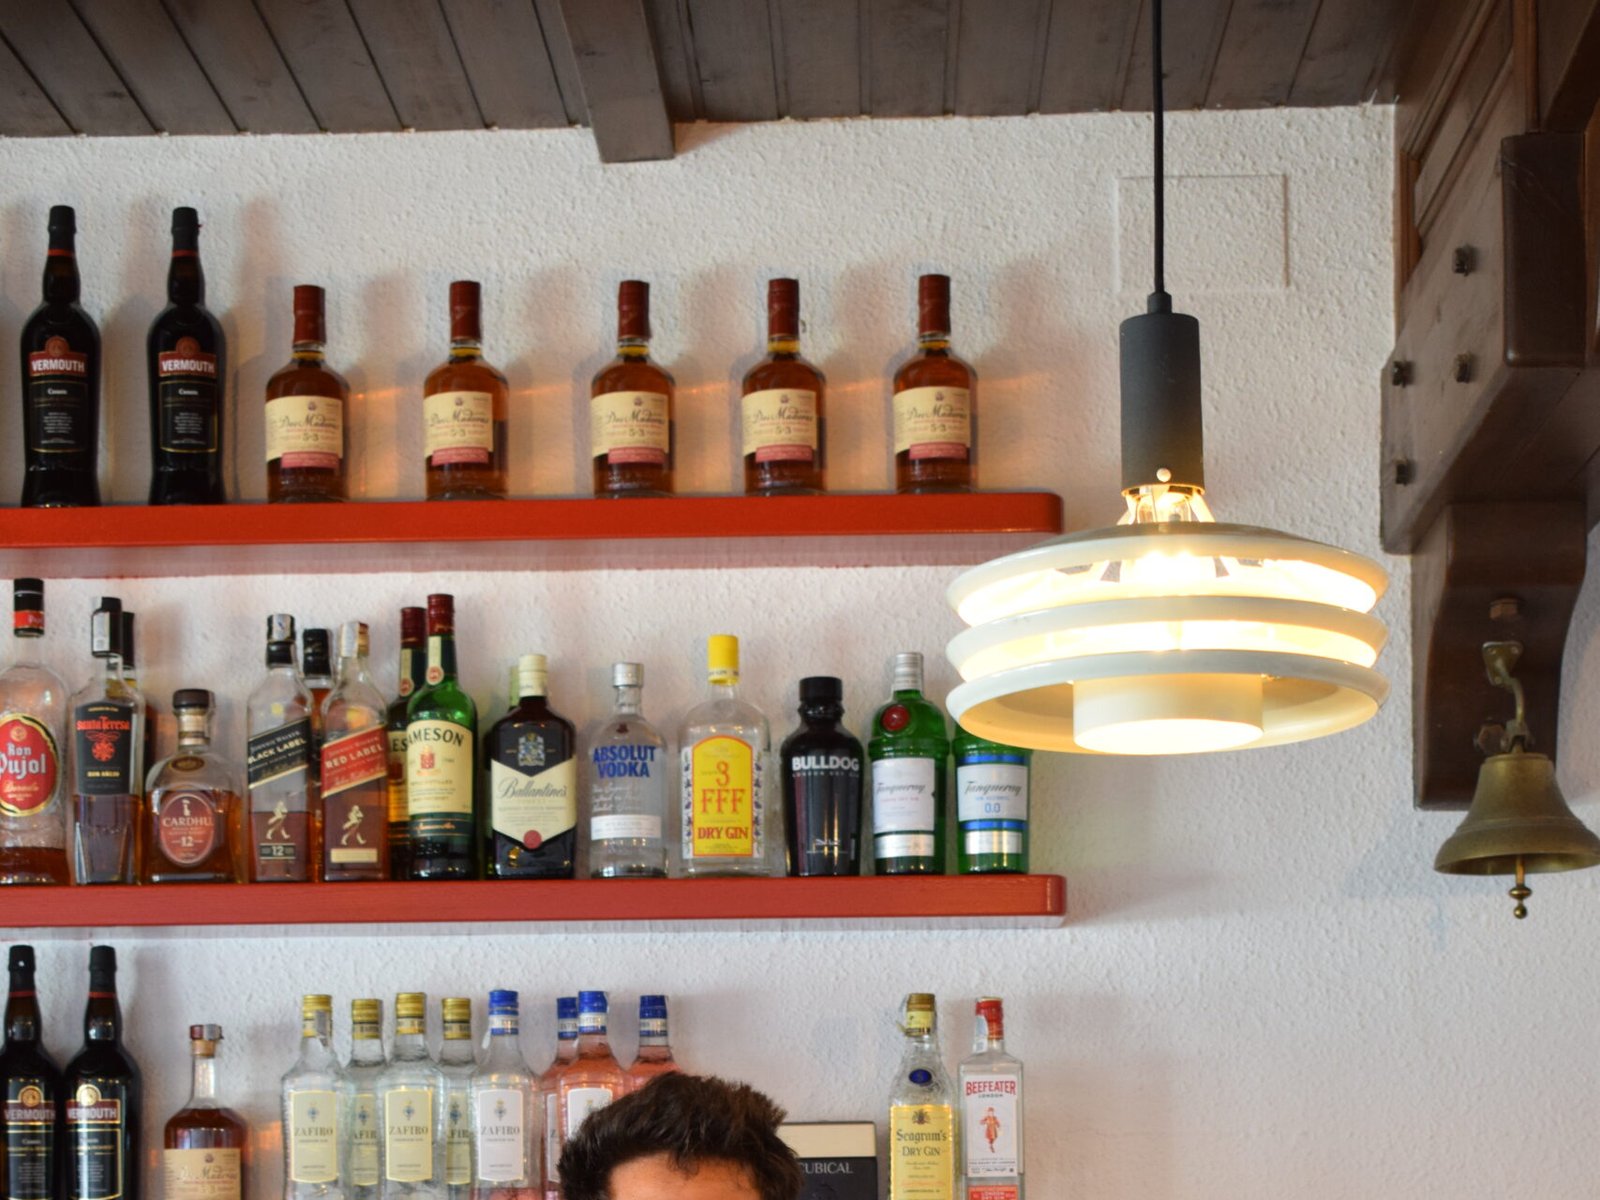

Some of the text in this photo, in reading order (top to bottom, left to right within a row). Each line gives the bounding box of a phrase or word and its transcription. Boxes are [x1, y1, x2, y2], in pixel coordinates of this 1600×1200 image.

[31, 359, 85, 373] VERMOUTH
[162, 359, 215, 373] VERMOUTH
[277, 737, 307, 752] LABEL
[408, 727, 464, 747] AMESON
[7, 742, 32, 756] Ron
[325, 754, 348, 770] RED
[350, 743, 384, 760] LABEL
[593, 745, 657, 763] ABSOLUT
[598, 762, 651, 779] VODKA
[791, 755, 859, 771] BULLDOG
[716, 760, 731, 787] 3
[497, 777, 568, 800] Ballantine's
[964, 781, 1022, 797] Tanqueray
[702, 788, 746, 814] FFF
[698, 826, 749, 840] DRY GIN
[181, 836, 194, 847] 12
[272, 846, 284, 856] 12
[966, 1081, 1016, 1096] BEEFEATER
[4, 1108, 57, 1121] VERMOUTH
[294, 1126, 334, 1137] ZAFIRO
[388, 1125, 429, 1136] ZAFIRO
[481, 1126, 520, 1137] ZAFIRO
[896, 1128, 948, 1144] Seagram's
[902, 1146, 940, 1157] DRY GIN
